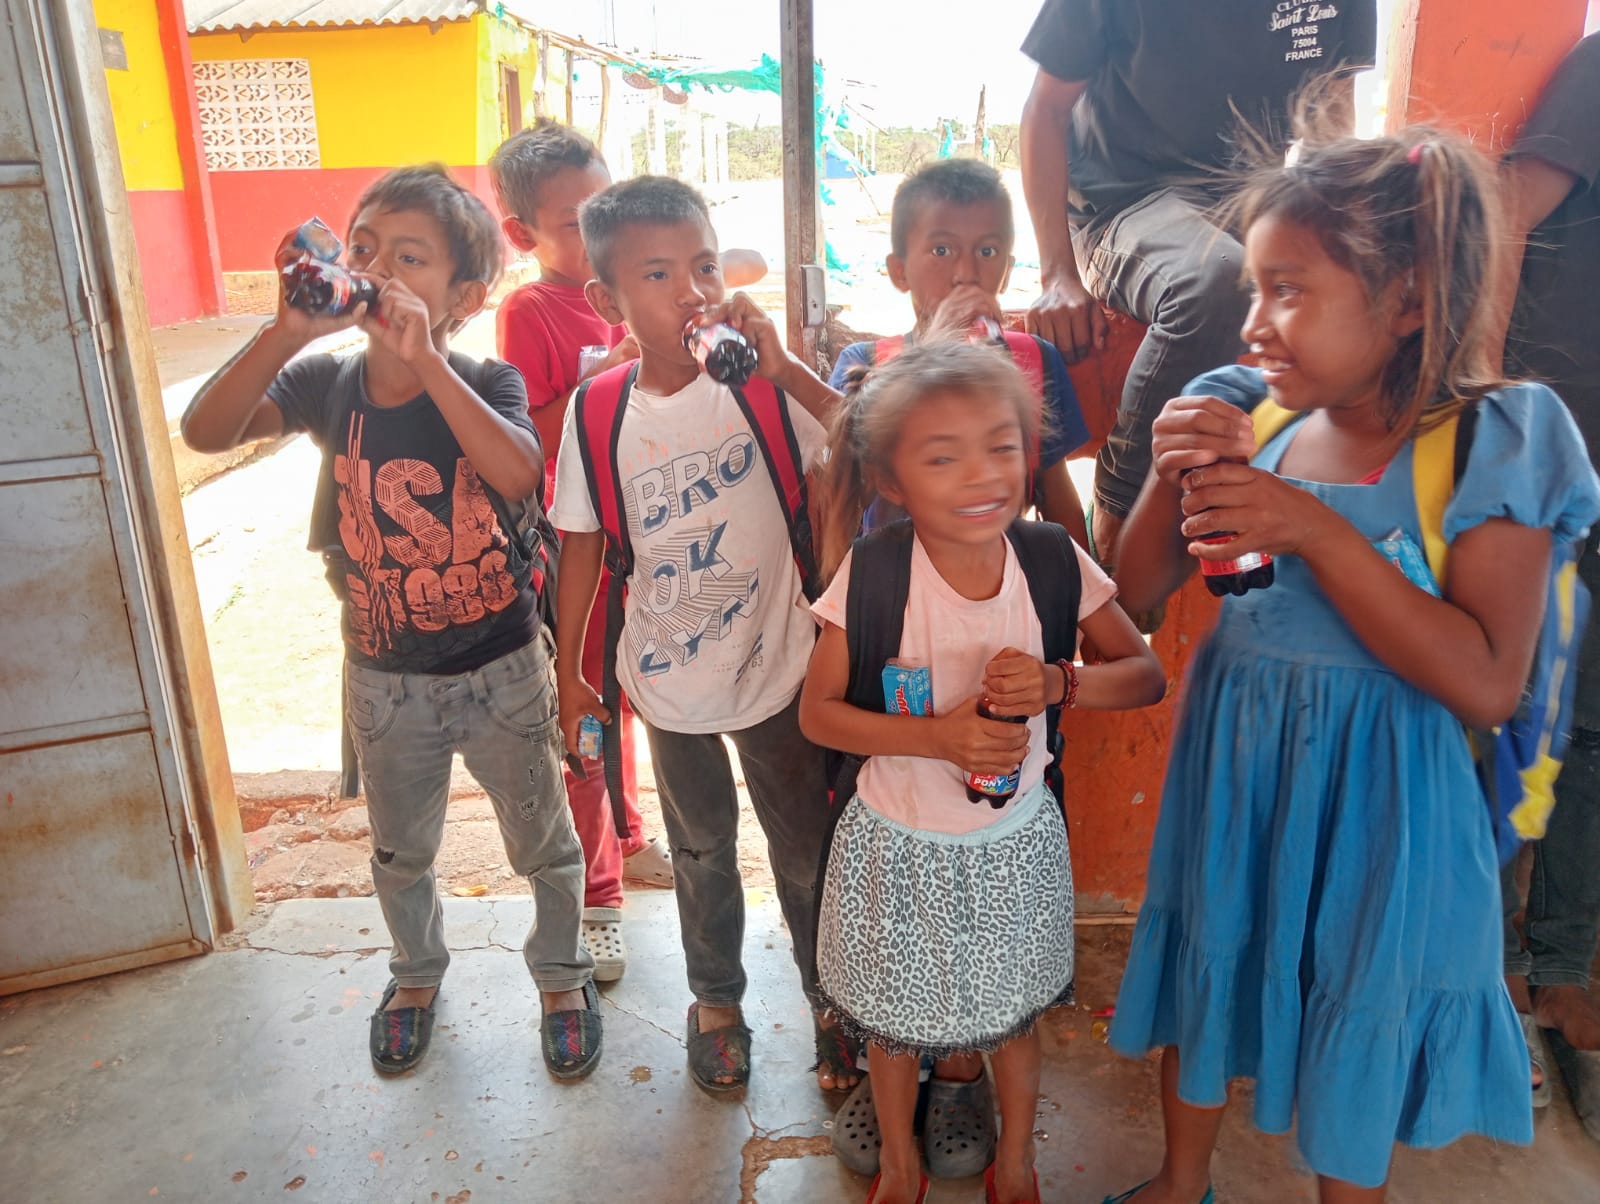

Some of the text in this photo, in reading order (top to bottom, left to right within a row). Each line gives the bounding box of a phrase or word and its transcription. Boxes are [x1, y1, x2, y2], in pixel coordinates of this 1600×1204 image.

[1268, 7, 1306, 31] Saint
[1291, 25, 1319, 37] PARIS
[1285, 47, 1323, 62] FRANCE
[631, 432, 757, 538] BRO
[647, 520, 734, 616] OK
[638, 567, 759, 679] LYN
[973, 777, 1005, 788] PONY
